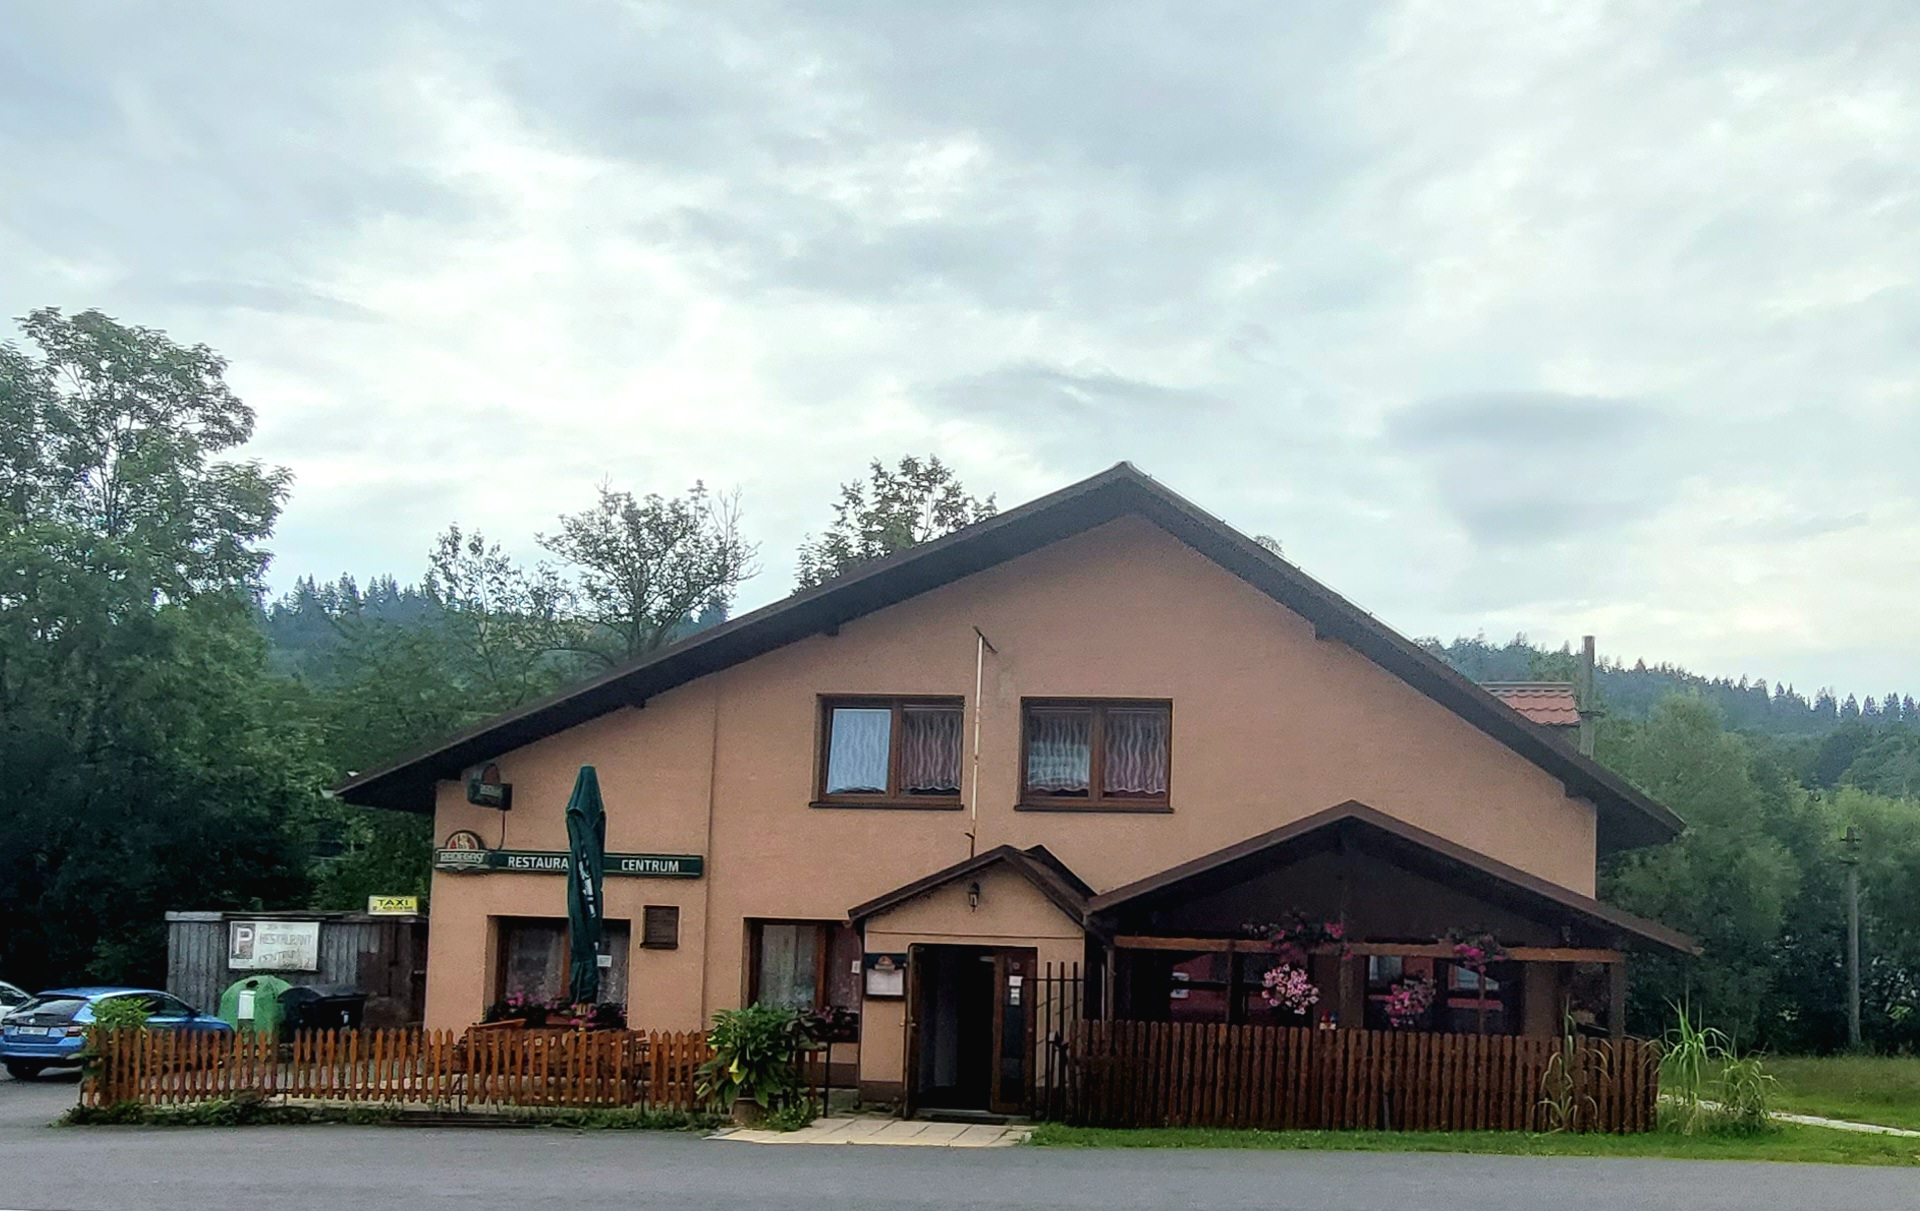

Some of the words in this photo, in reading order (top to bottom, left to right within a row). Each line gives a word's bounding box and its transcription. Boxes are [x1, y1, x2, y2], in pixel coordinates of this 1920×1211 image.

[508, 856, 569, 869] RESTAURA
[621, 859, 679, 873] CENTRUM
[376, 898, 409, 906] TAXI
[235, 927, 253, 955] P
